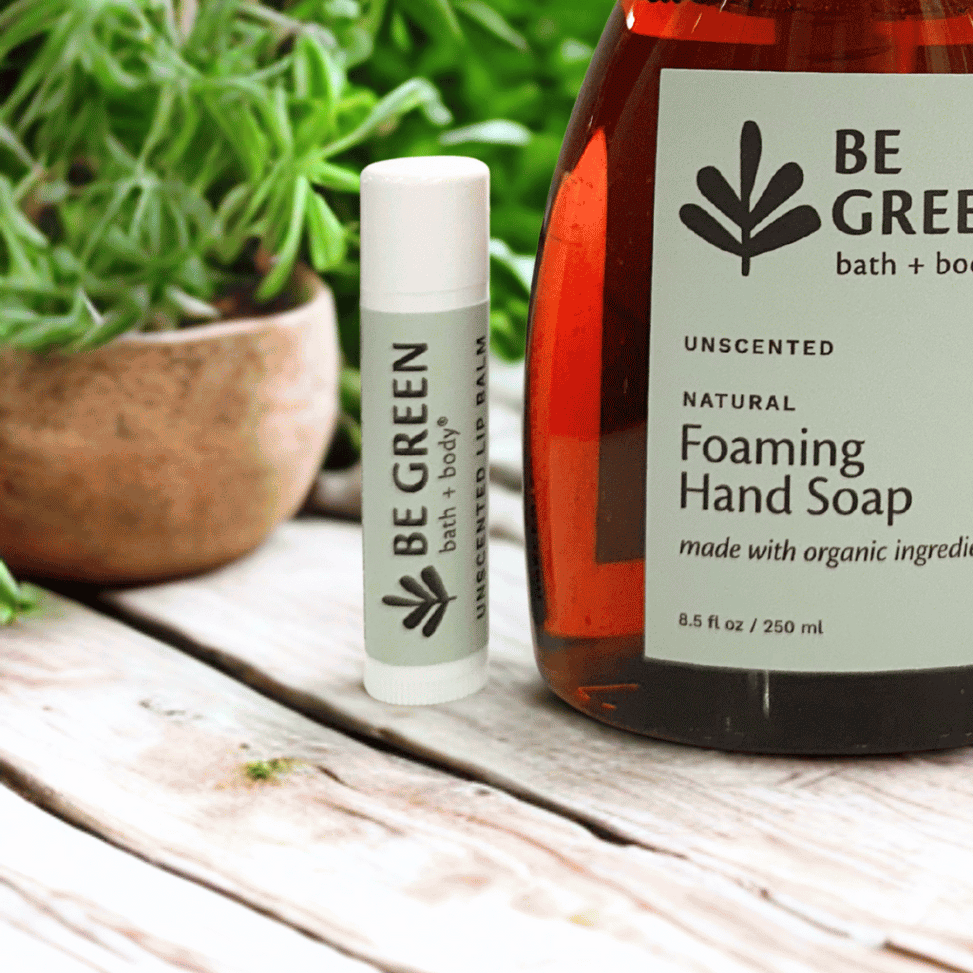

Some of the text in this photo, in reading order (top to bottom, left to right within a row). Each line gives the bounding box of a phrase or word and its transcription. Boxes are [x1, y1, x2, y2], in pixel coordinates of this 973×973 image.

[835, 128, 902, 175] BE
[836, 252, 897, 276] bath
[908, 258, 925, 275] +
[684, 335, 834, 357] UNSCENTED
[683, 391, 797, 412] NATURAL
[392, 342, 429, 556] BE GREEN
[680, 423, 866, 479] Foaming
[441, 486, 457, 499] +
[475, 334, 488, 621] UNSCENTED LIP BALM
[679, 470, 913, 527] Hand Soap
[437, 505, 457, 555] bath
[679, 536, 742, 560] made
[748, 538, 797, 562] with
[802, 542, 888, 569] organic
[678, 612, 824, 635] 8.5 fl oz / 250 ml
